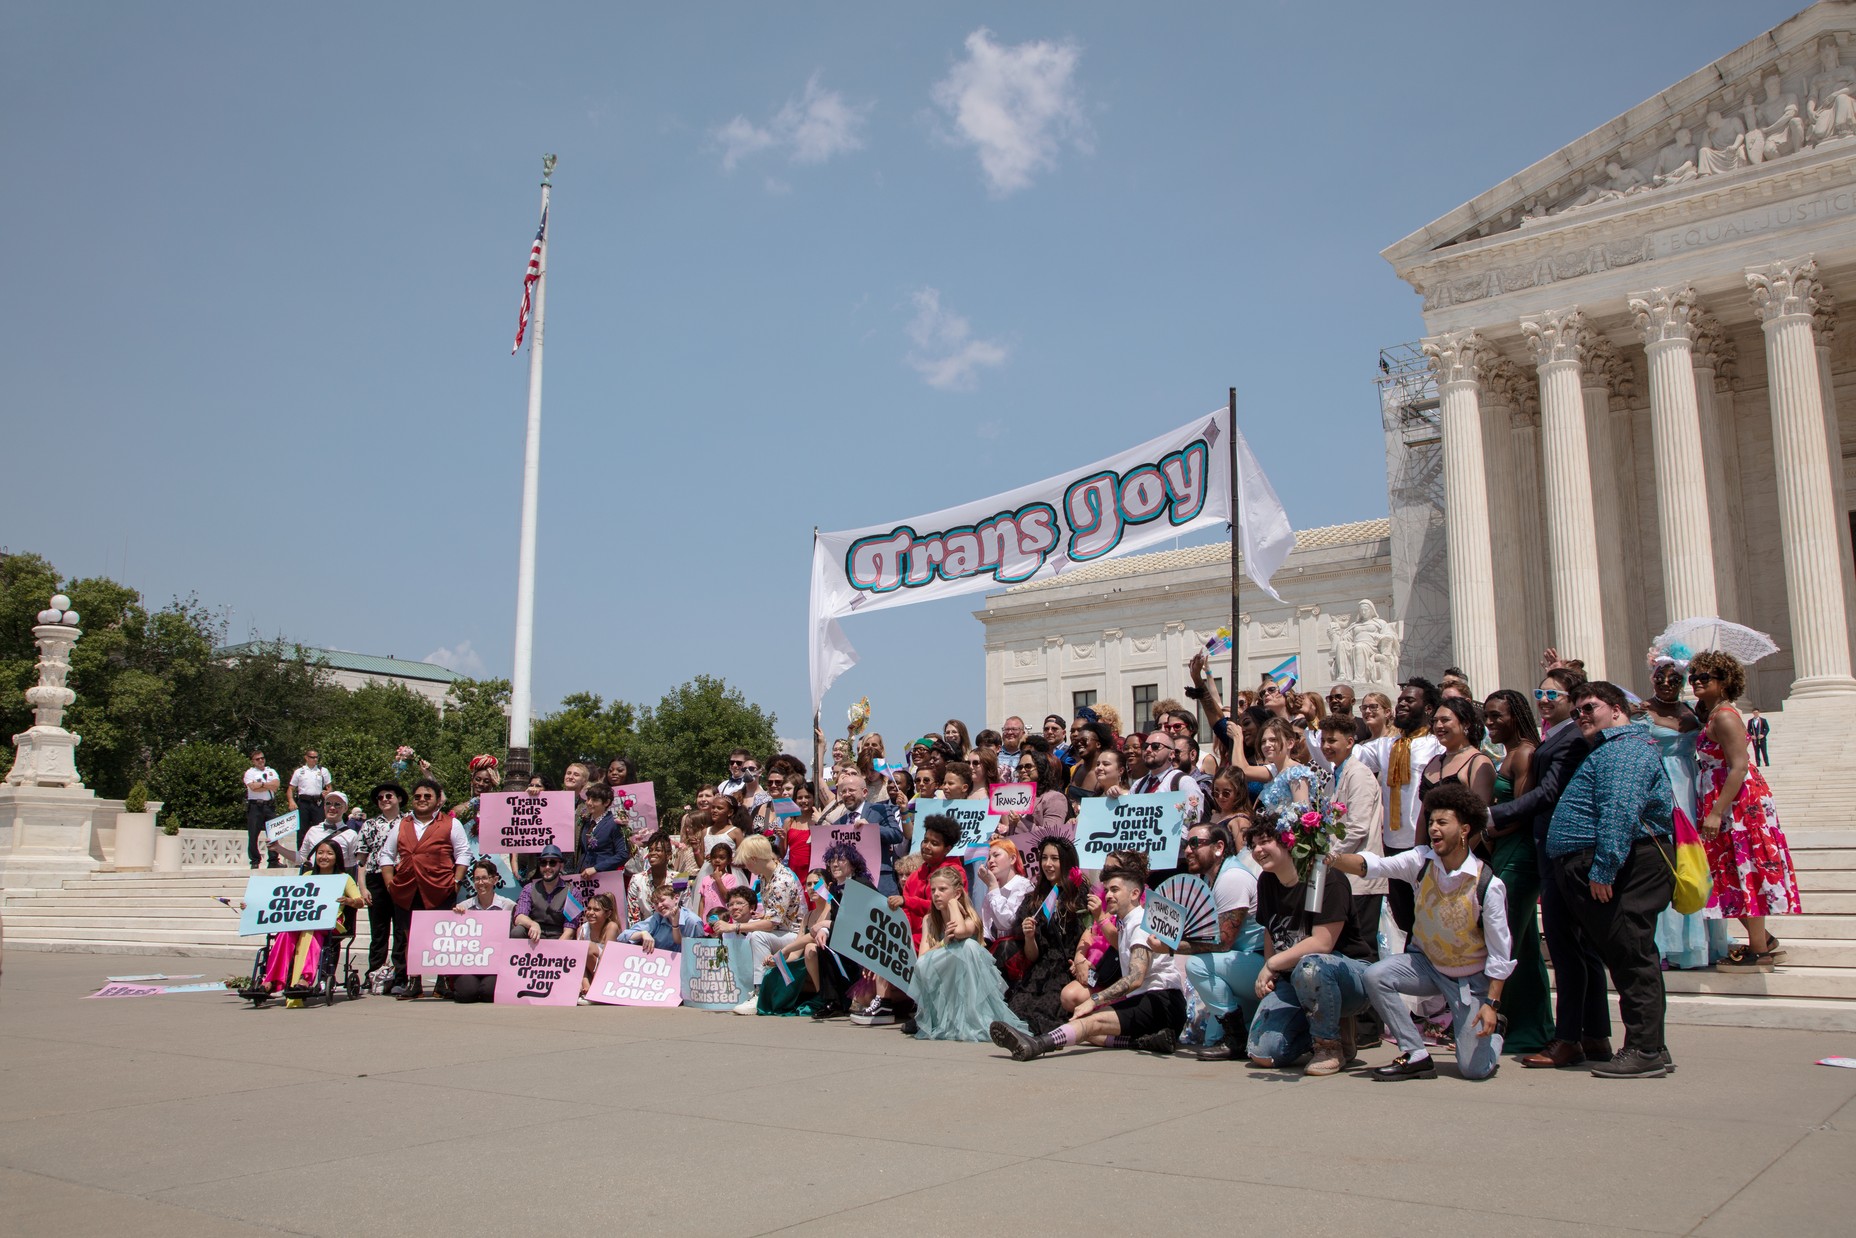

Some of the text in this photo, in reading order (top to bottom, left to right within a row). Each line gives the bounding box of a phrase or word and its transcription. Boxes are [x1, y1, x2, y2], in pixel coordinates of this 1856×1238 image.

[1670, 220, 1755, 250] EQUAL
[846, 439, 1209, 593] Trans Joy
[506, 796, 548, 807] Trans
[513, 804, 541, 815] Kids
[946, 807, 985, 821] Trans
[1114, 803, 1164, 818] Trans
[270, 820, 285, 830] TRANS
[511, 814, 543, 826] Have
[1089, 816, 1163, 840] youth
[501, 826, 552, 837] Always
[831, 829, 861, 842] Trans
[1120, 830, 1147, 840] are
[501, 834, 555, 847] Existed
[1084, 836, 1167, 855] Powerful
[272, 882, 320, 898] You
[269, 898, 315, 911] Are
[257, 904, 327, 925] Loved
[434, 918, 483, 937] You
[869, 908, 912, 950] You
[1151, 916, 1179, 942] STRONG
[432, 937, 480, 953] Are
[865, 925, 909, 965] Are
[422, 947, 494, 967] Loved
[509, 952, 577, 974] Celebrate
[851, 931, 916, 984] Loved
[517, 967, 561, 980] Trans
[624, 955, 672, 978] You
[701, 967, 734, 981] Have
[517, 979, 554, 999] Joy
[618, 971, 665, 991] Are
[689, 977, 736, 993] Always
[602, 981, 676, 1002] Loved
[690, 988, 741, 1004] Existed
